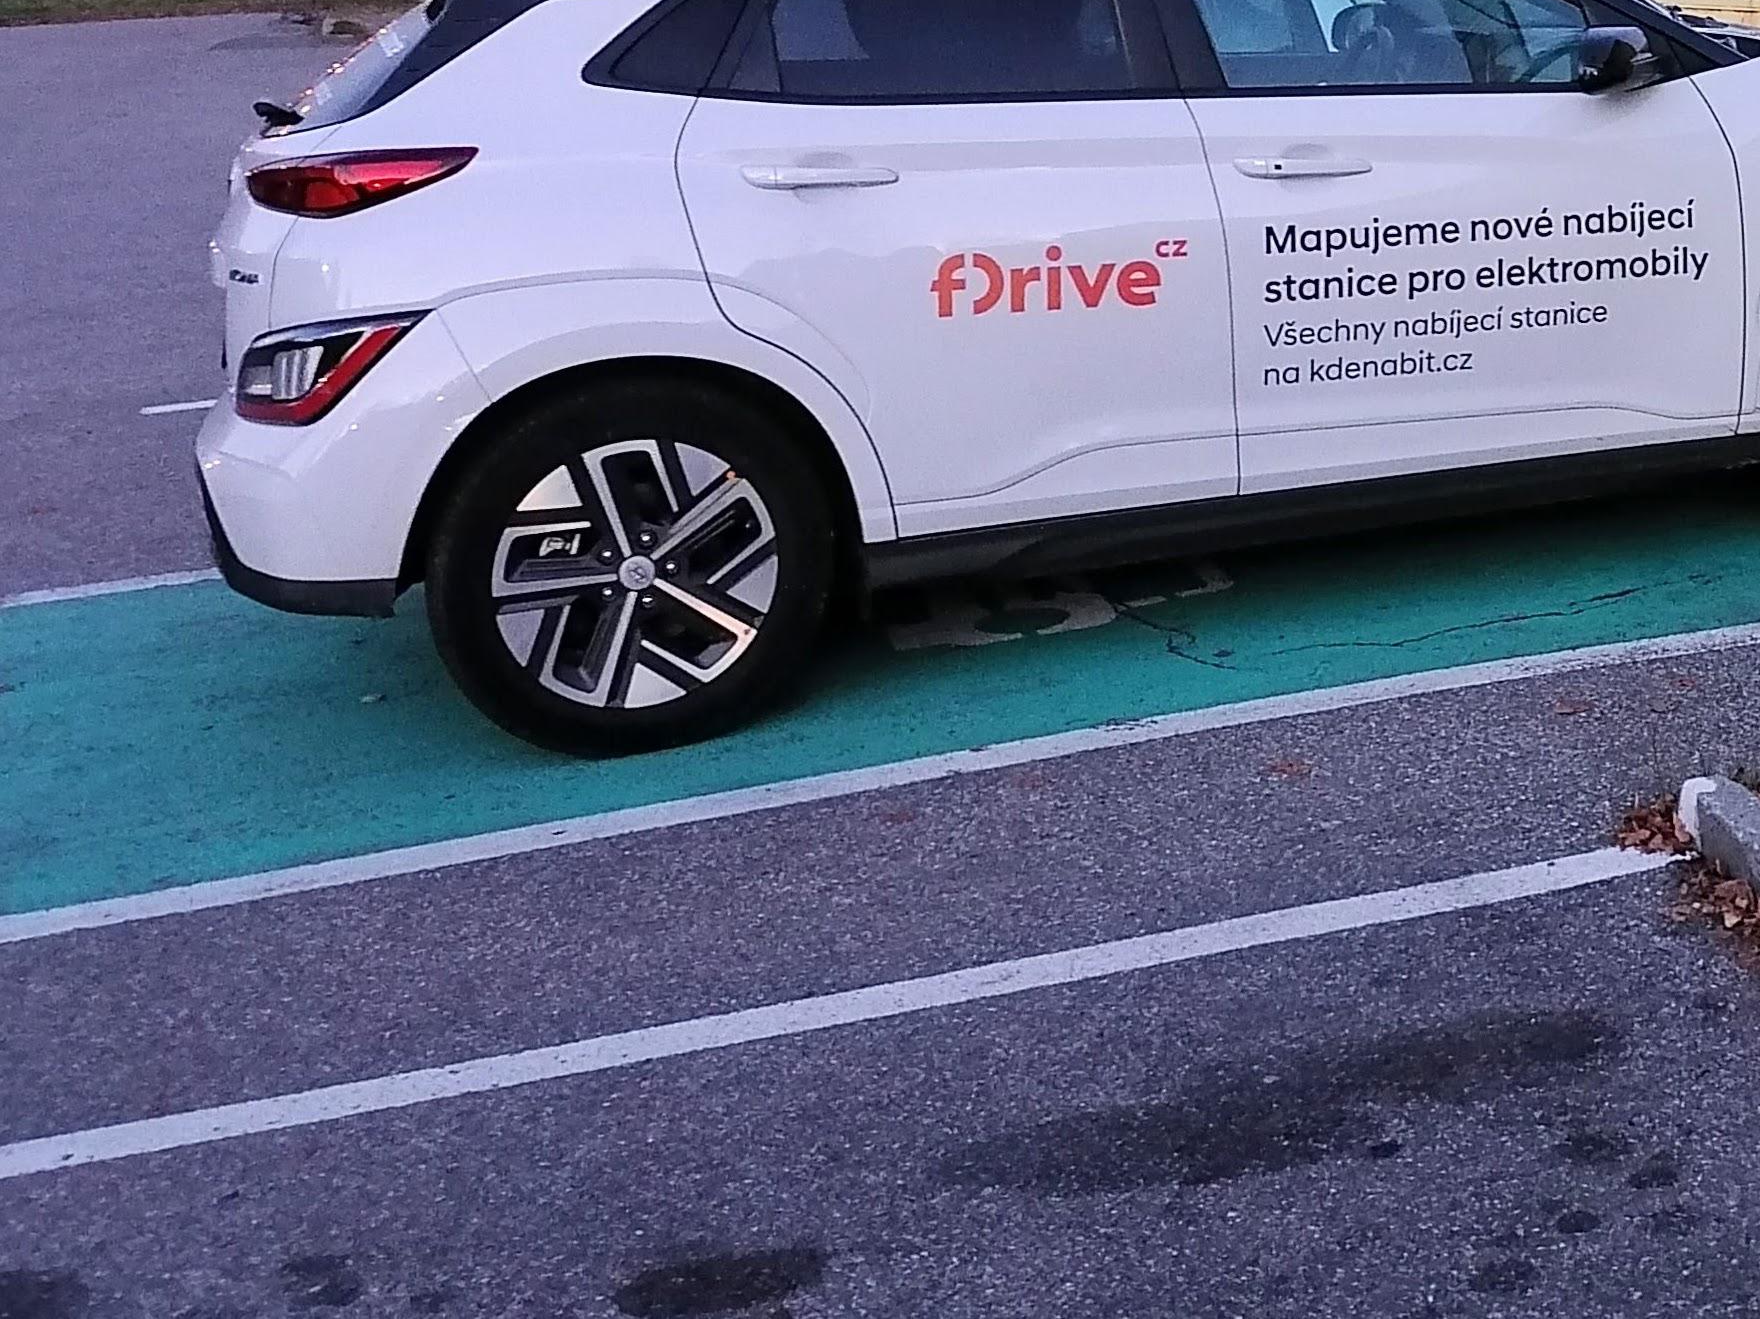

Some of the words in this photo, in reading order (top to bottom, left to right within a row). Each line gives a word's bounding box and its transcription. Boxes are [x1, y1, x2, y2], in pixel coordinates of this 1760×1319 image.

[1265, 217, 1460, 257] Mapujeme
[1470, 207, 1553, 241] nové
[1563, 199, 1695, 238] nabíjecí
[1265, 267, 1397, 303] stanice
[1408, 268, 1465, 300] pro
[1476, 246, 1709, 288] elektromobily
[1264, 318, 1386, 347] Všechny
[1394, 305, 1503, 338] nabíjecí
[1510, 301, 1608, 329] stanice
[1264, 367, 1300, 386] na
[1310, 349, 1473, 382] kdenabit.cz
